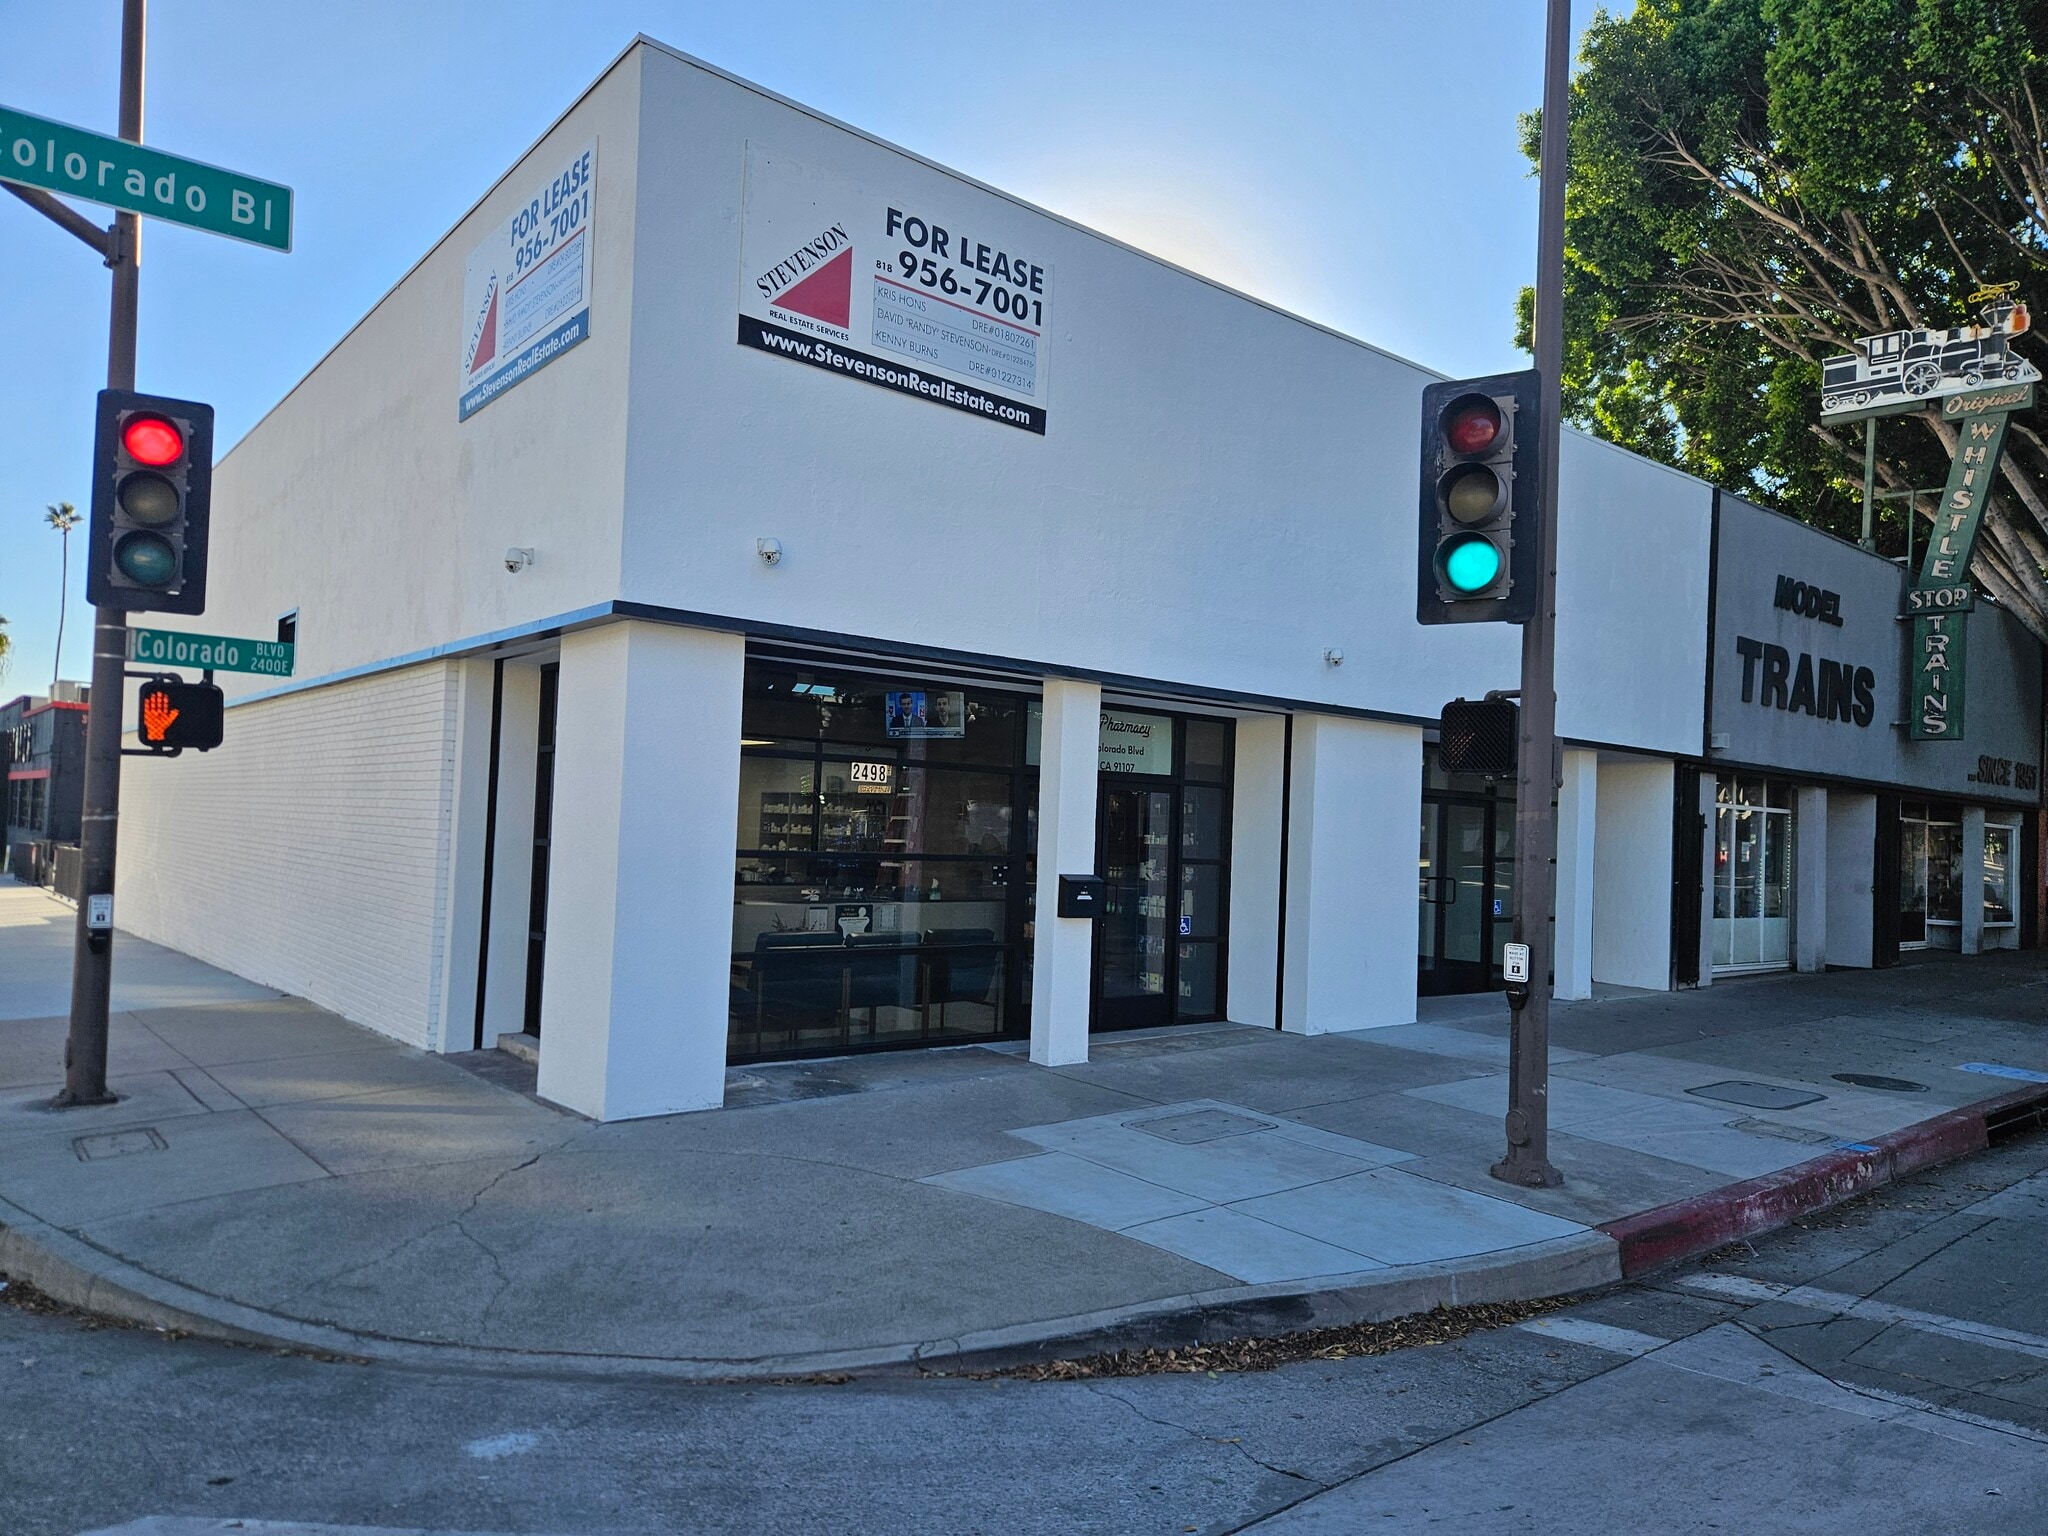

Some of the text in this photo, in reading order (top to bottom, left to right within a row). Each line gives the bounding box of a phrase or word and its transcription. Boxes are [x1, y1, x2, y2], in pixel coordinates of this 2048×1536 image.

[0, 130, 272, 231] olorado Bl
[511, 151, 590, 247] FOR LEASE
[515, 190, 588, 274] 956-7001
[756, 222, 849, 298] STEVENSON
[886, 207, 1044, 295] FOR LEASE
[875, 250, 1042, 327] 818 956-7001
[877, 286, 1034, 349] KRIS HONS DRE#01807261
[465, 269, 497, 373] STEVENSON
[769, 309, 849, 341] REAL ESTATE SERVICES
[876, 329, 907, 348] KENNY
[909, 340, 939, 360] BURNS
[877, 307, 904, 325] DAVID
[941, 329, 989, 355] STEVENSON
[465, 323, 579, 412] www.StevensonRealEstate.com
[761, 330, 1031, 425] www.StevensonRealEstate.com
[1946, 384, 2029, 414] Original
[1931, 421, 1999, 579] WHISTLE
[1774, 574, 1844, 627] MODEL
[1909, 588, 1968, 609] STOP
[137, 631, 285, 666] Colorado BLVD
[250, 657, 289, 674] 2400E
[1923, 615, 1949, 735] TRAINS
[1737, 635, 1875, 728] TRAINS
[1098, 742, 1145, 756] olorado Blvd
[1099, 713, 1151, 737] Pharmacy
[853, 763, 886, 782] 2498
[1099, 761, 1136, 772] CA 91107
